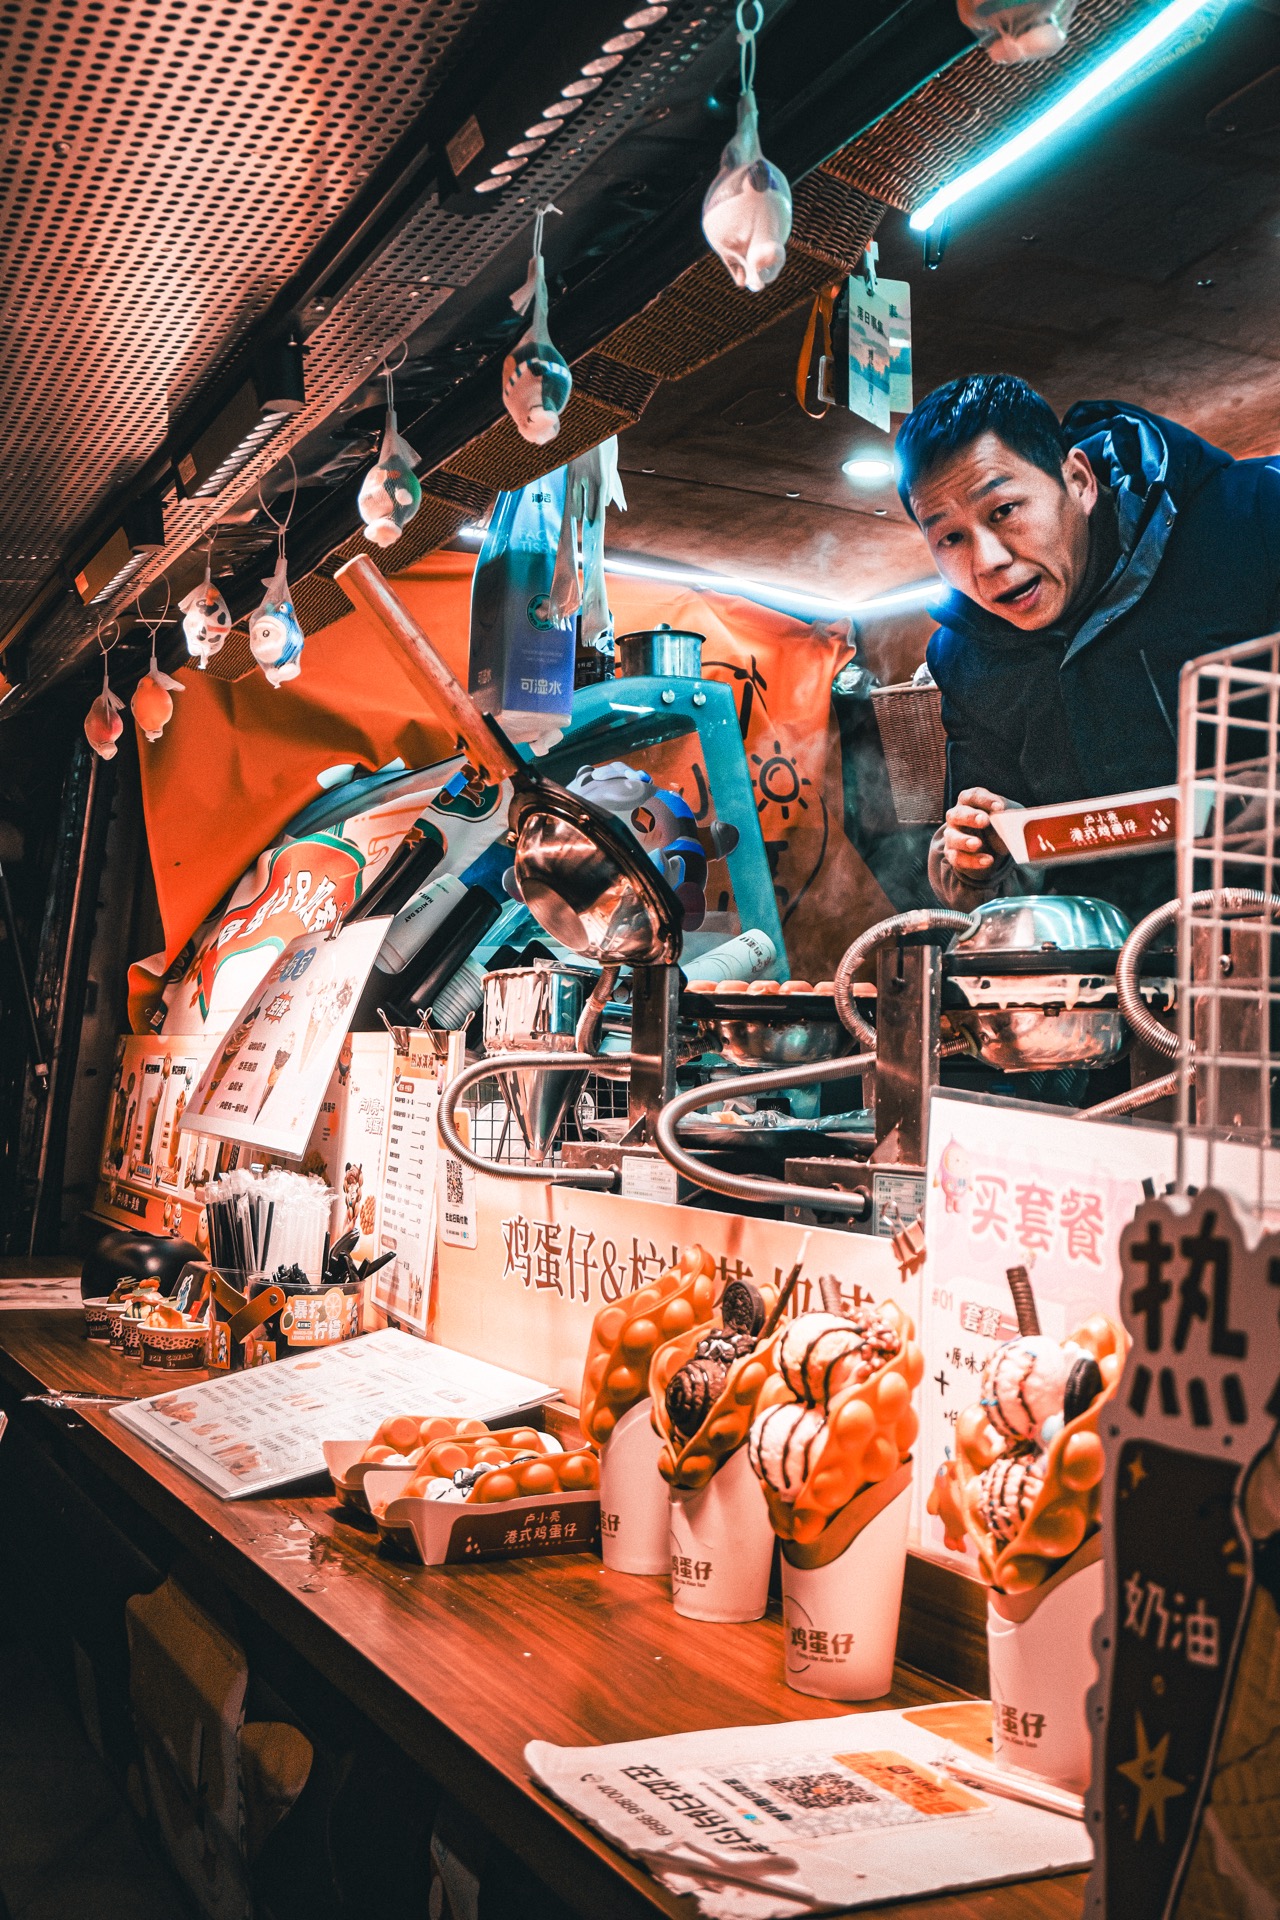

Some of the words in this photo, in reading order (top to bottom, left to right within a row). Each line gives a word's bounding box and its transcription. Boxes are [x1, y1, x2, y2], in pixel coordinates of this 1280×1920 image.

[404, 913, 417, 923] DAY
[415, 901, 429, 915] NICE
[971, 1174, 1104, 1266] 买套餐
[1127, 1211, 1280, 1428] 热
[952, 1347, 986, 1375] 原味
[524, 1510, 561, 1527] 卢小亮
[503, 1523, 578, 1545] 港式鸡蛋仔
[1123, 1571, 1220, 1667] 奶油
[791, 1626, 855, 1655] 鸡蛋仔
[997, 1703, 1048, 1739] 蛋仔
[596, 1784, 623, 1798] 400
[614, 1797, 645, 1814] 886
[635, 1813, 673, 1836] 9999
